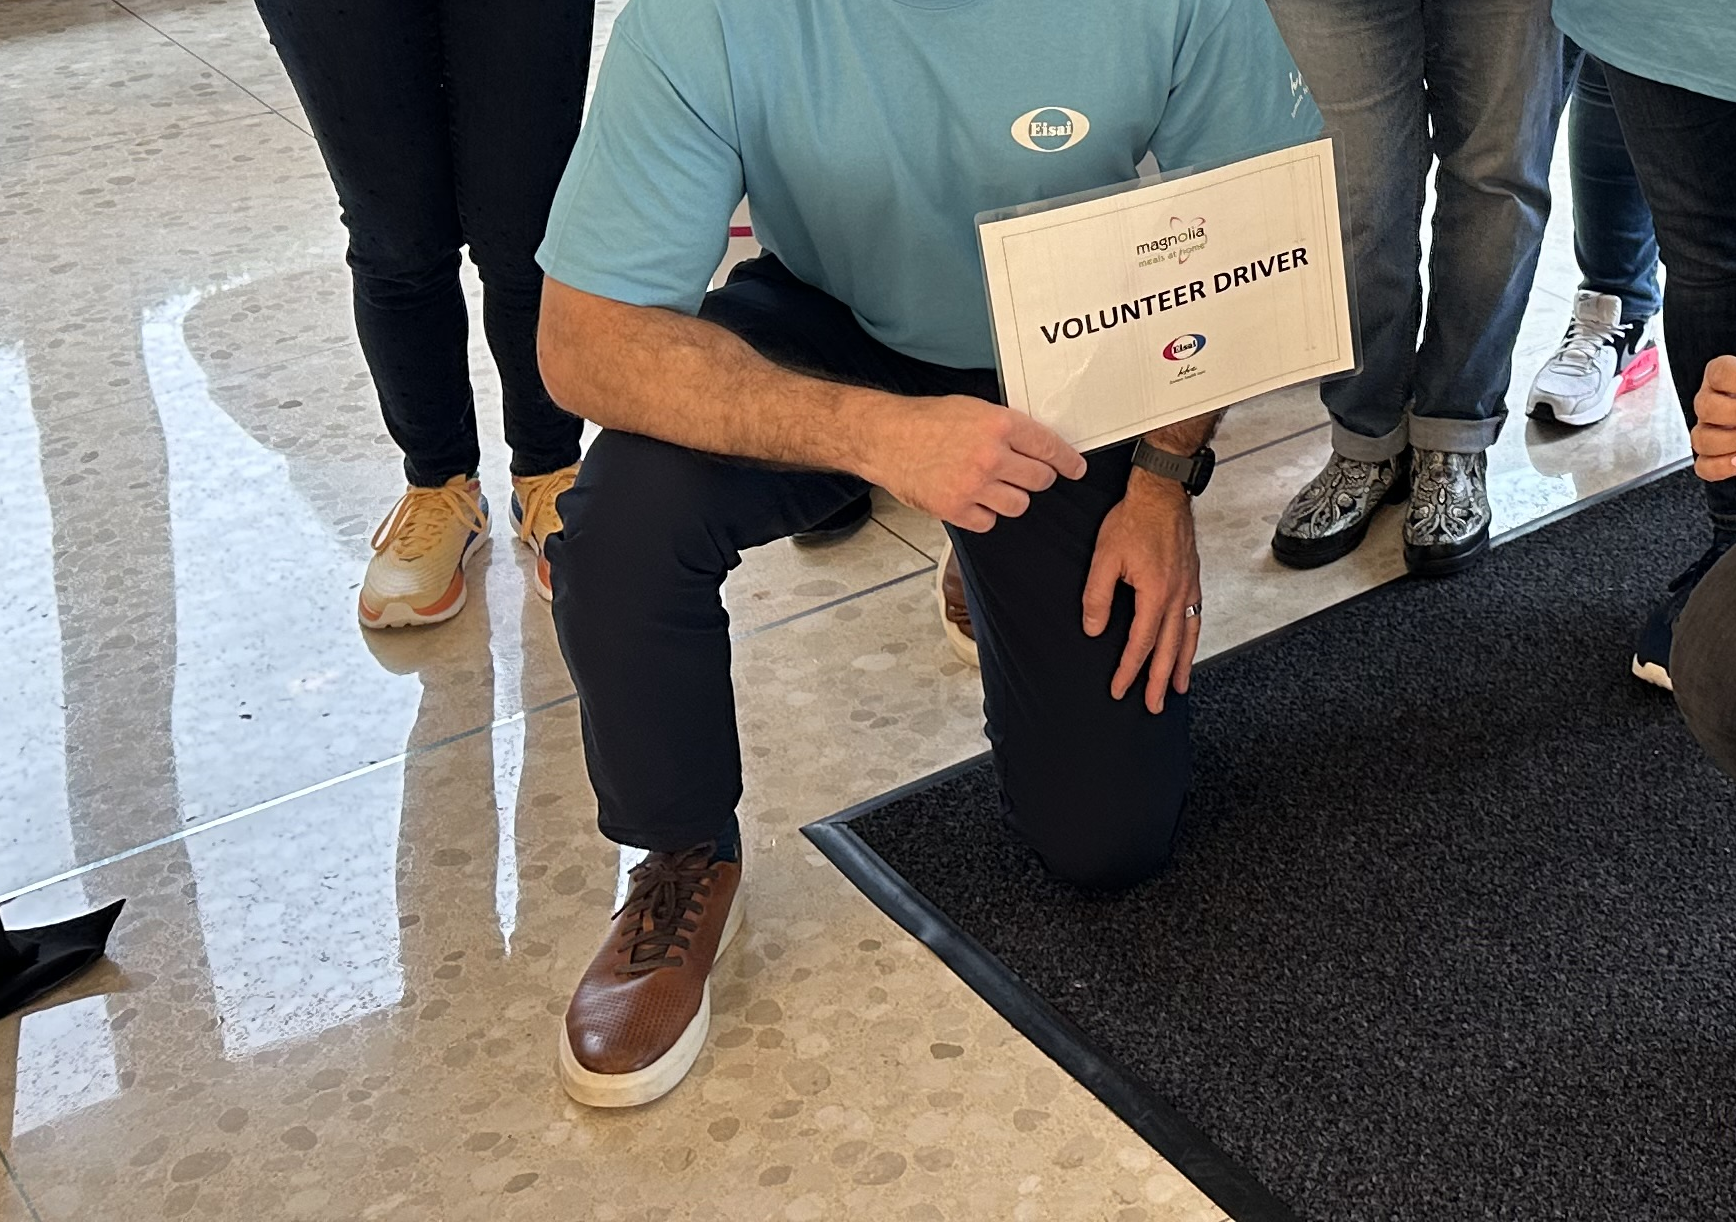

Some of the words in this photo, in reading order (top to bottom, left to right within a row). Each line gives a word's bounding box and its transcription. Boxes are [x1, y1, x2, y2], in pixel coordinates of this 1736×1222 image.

[1030, 121, 1073, 137] Eisai
[1137, 226, 1205, 255] magnolia
[1040, 280, 1206, 344] VOLUNTEER
[1214, 247, 1309, 293] DRIVER
